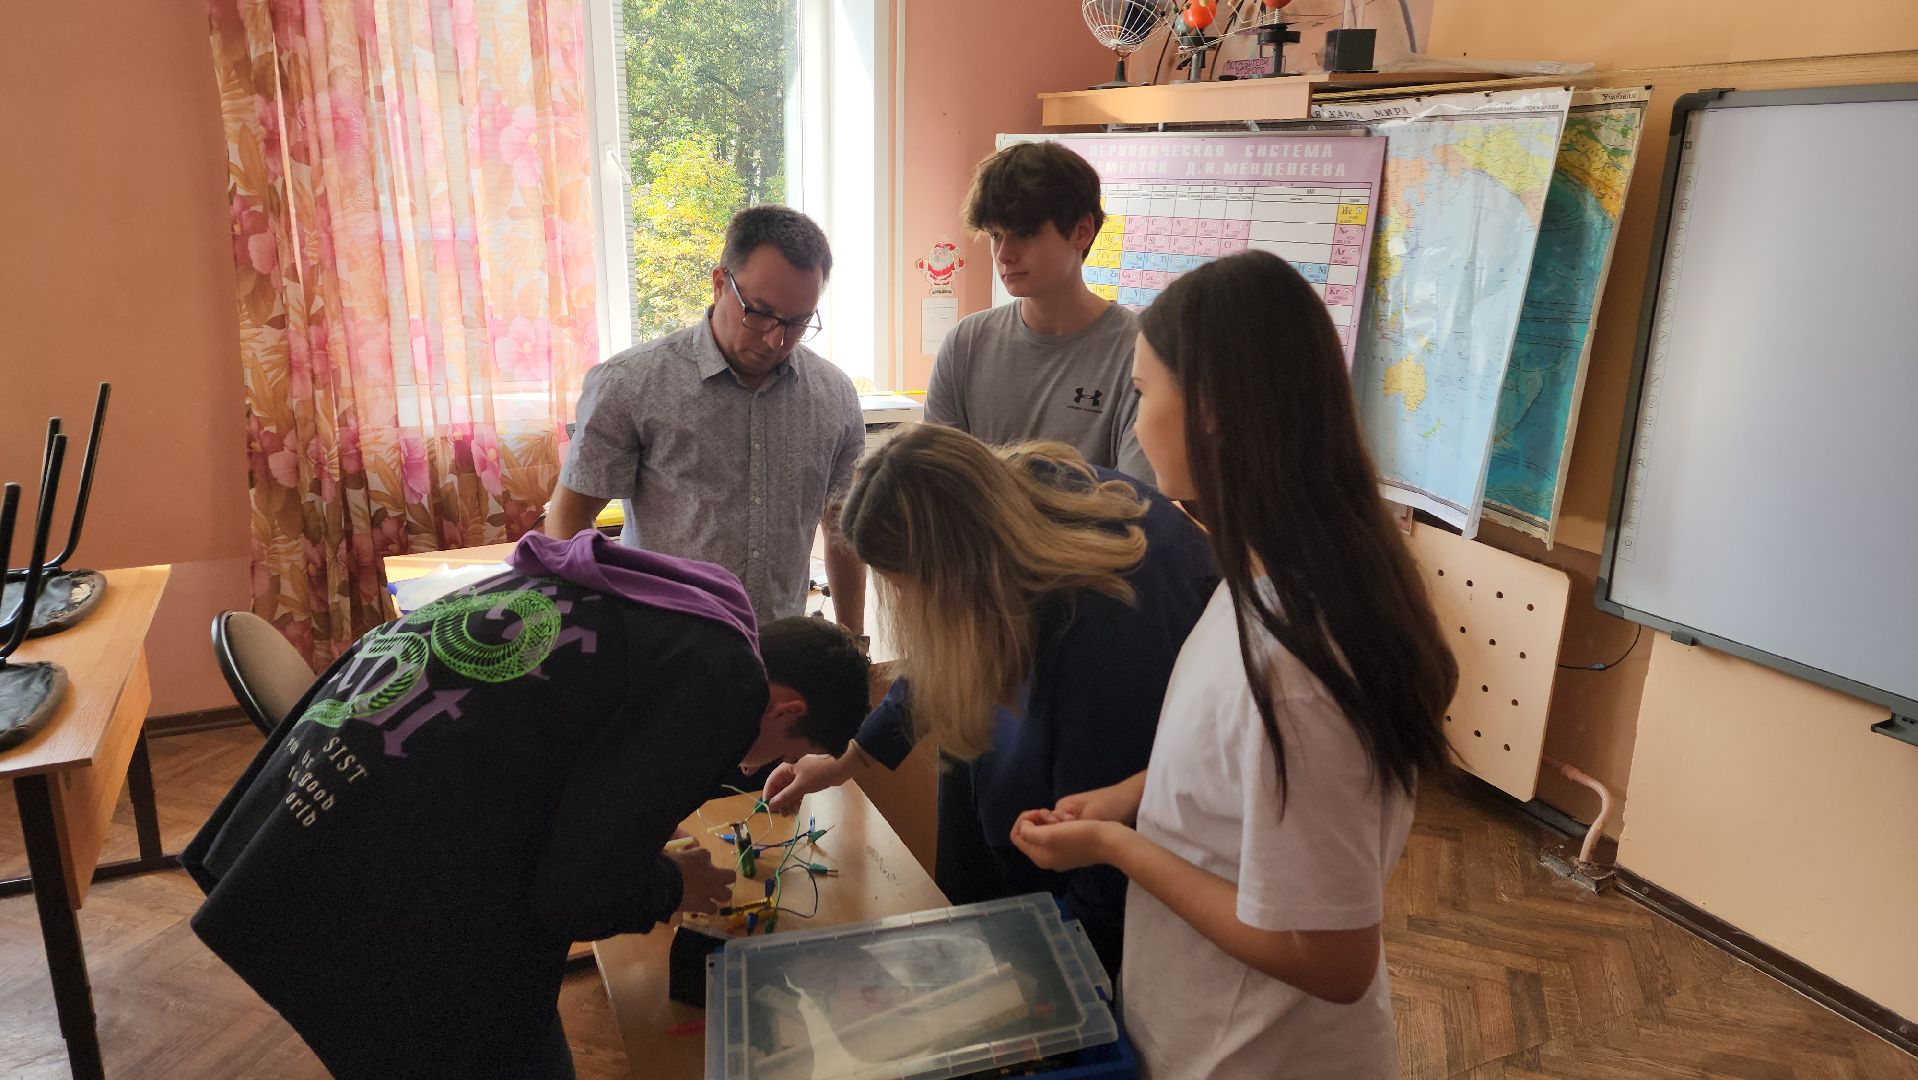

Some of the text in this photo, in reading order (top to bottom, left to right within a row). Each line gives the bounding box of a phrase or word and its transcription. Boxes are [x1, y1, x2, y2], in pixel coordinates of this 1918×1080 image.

[1374, 106, 1410, 117] МИРА
[1089, 143, 1333, 159] ПЕРИОДИЧЕСКАЯ СИСТЕМА
[1094, 160, 1168, 175] ЕМЕНТОВ
[323, 736, 368, 784] SIST
